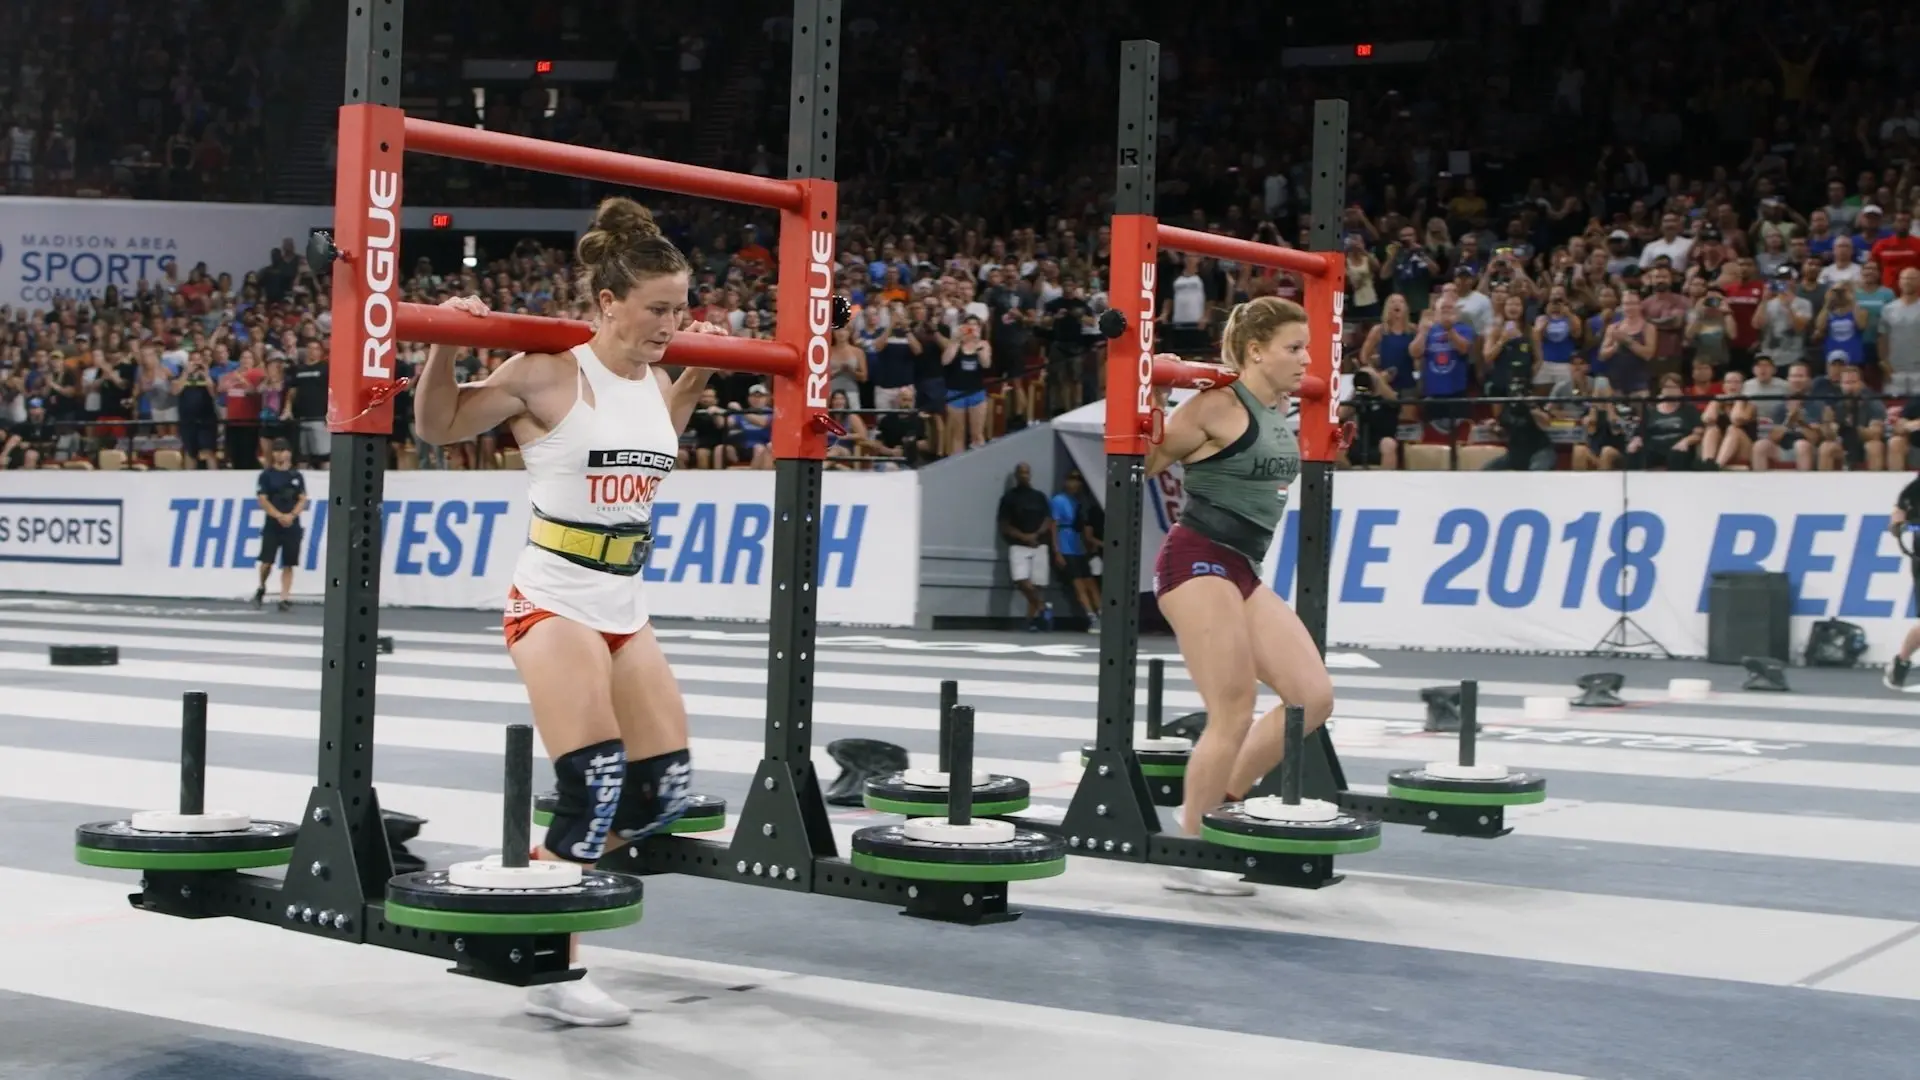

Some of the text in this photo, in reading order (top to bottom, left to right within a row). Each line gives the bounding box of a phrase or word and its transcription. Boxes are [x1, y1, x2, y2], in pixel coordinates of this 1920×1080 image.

[21, 234, 177, 250] MADISON AREA
[363, 169, 397, 379] ROGUE
[807, 230, 832, 408] ROGUE
[1138, 262, 1156, 414] ROGUE
[1329, 290, 1344, 424] ROGUE
[602, 451, 675, 471] LEADER
[17, 516, 113, 545] SPORTS
[169, 498, 262, 568] THE
[642, 502, 869, 588] EARH
[1422, 508, 1665, 612] 2018
[570, 750, 625, 859] CrossFit
